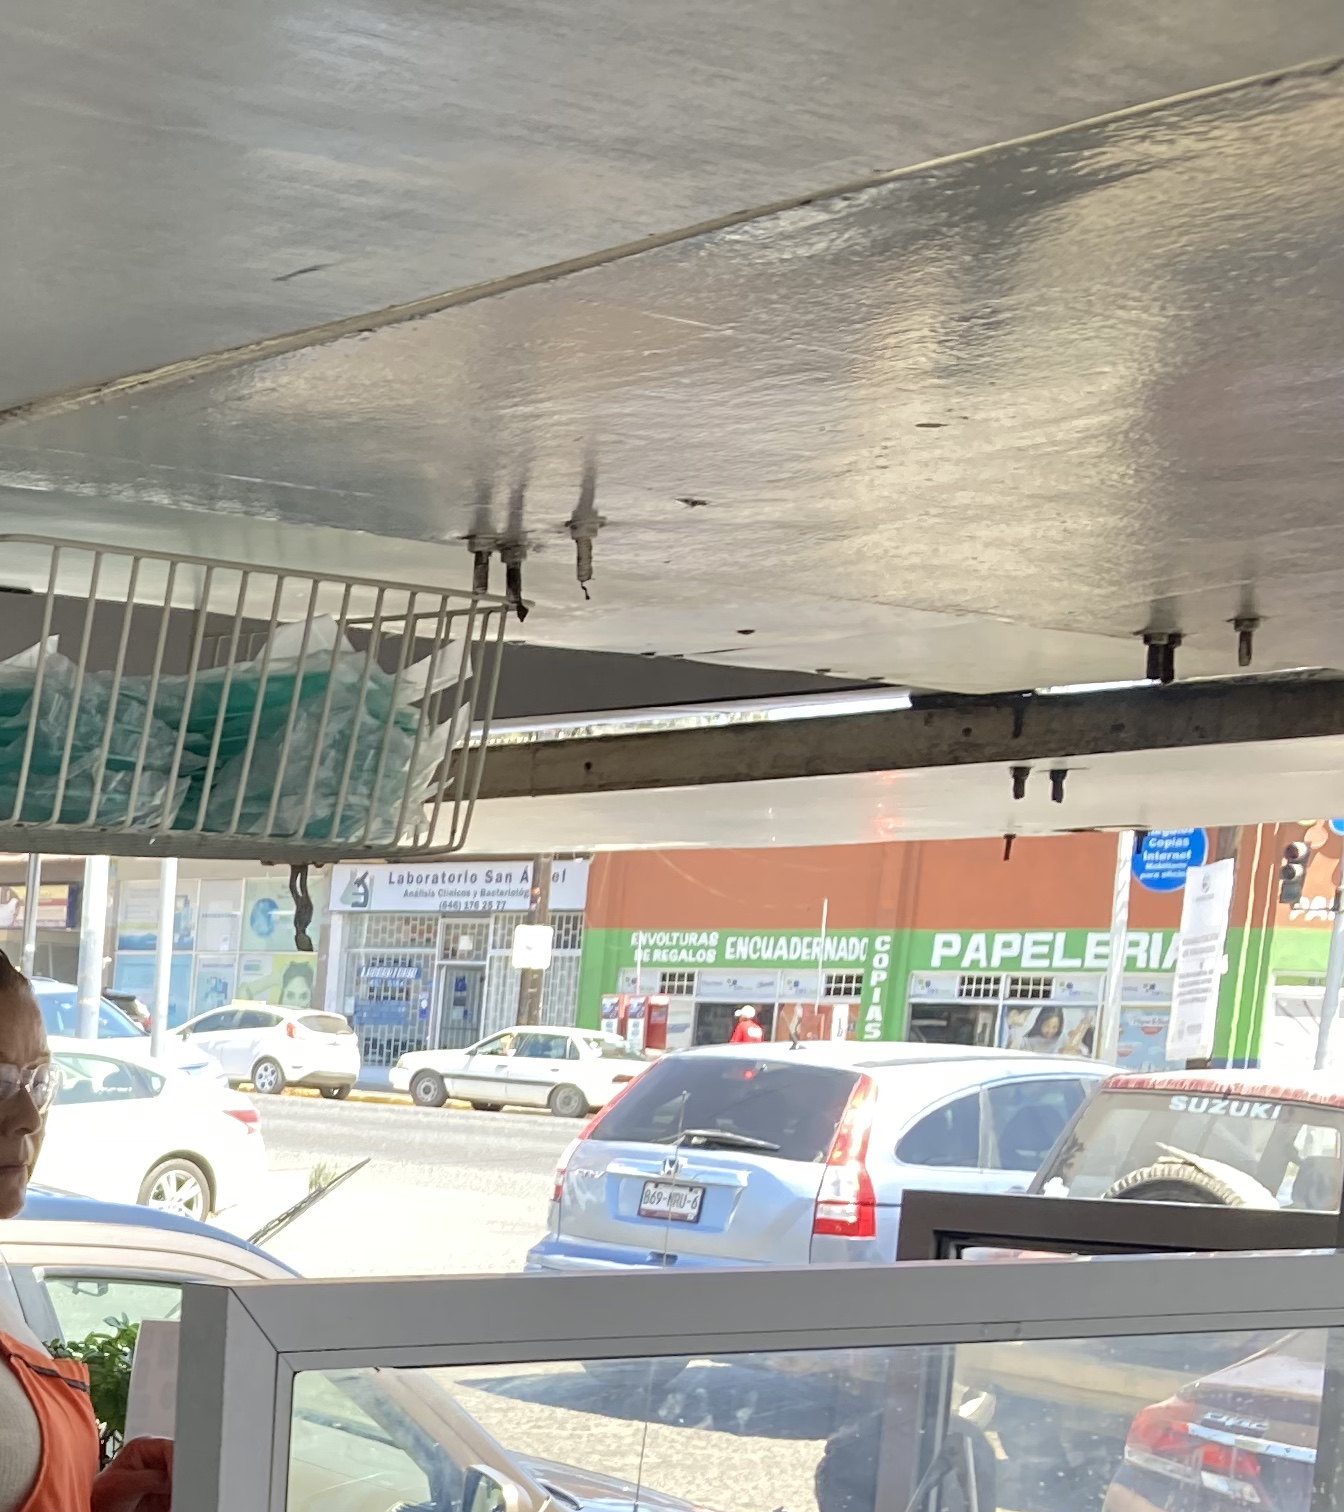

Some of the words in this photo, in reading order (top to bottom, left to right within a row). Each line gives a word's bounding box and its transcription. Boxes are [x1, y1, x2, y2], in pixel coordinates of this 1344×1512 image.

[1148, 837, 1190, 849] Copias
[1143, 849, 1192, 861] Internet
[388, 869, 478, 885] Laboratorio
[484, 869, 513, 884] San
[482, 900, 493, 910] 25
[494, 900, 507, 910] 77
[631, 931, 719, 948] ENVOLTURAS
[634, 949, 651, 963] DE
[653, 948, 716, 963] REGALOS
[863, 935, 891, 1040] COPIAS
[1168, 1095, 1282, 1120] SUZUKI
